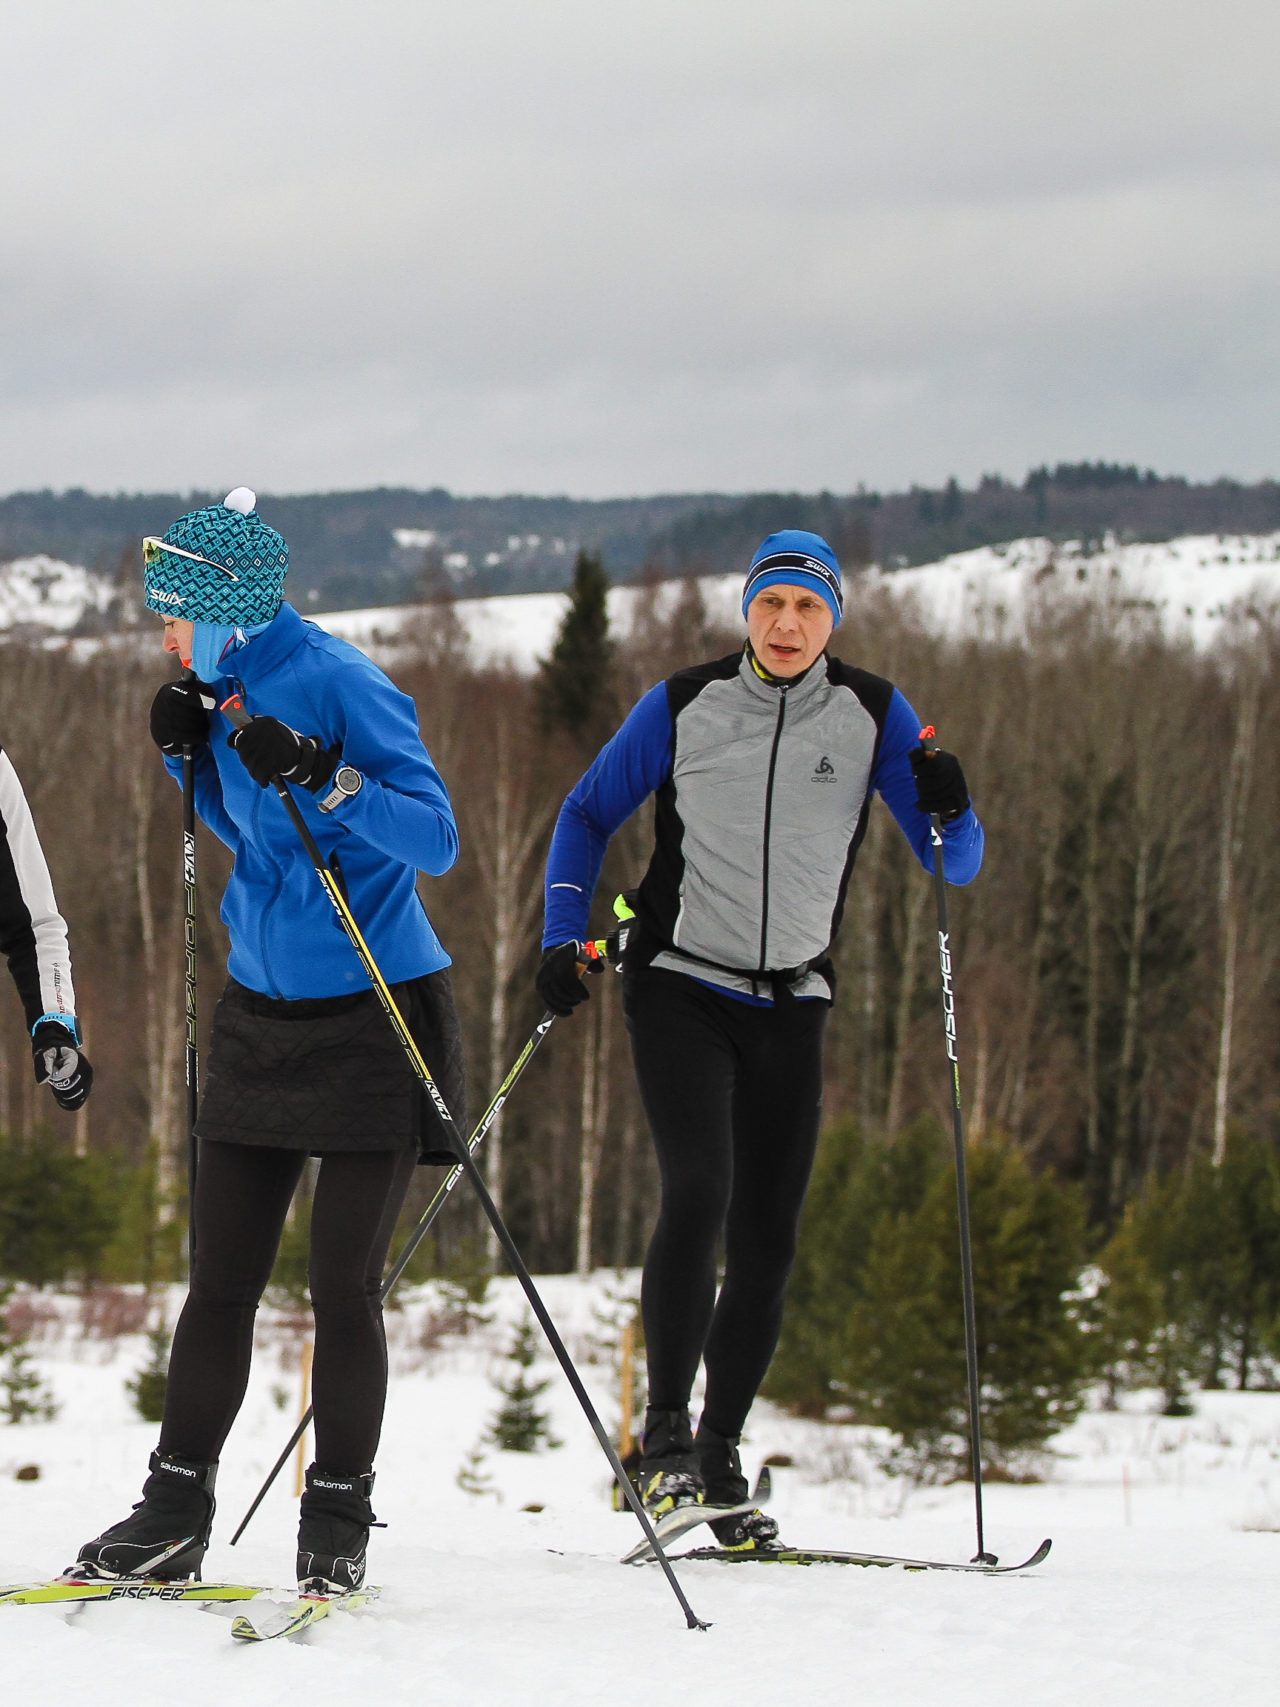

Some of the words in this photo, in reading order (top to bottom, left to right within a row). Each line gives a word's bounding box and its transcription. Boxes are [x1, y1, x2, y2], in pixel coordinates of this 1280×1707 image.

[938, 930, 958, 1062] FISCHER
[424, 1080, 453, 1121] KV+
[160, 1461, 197, 1478] salomon
[313, 1479, 353, 1491] salomon
[107, 1586, 186, 1601] FISCHER
